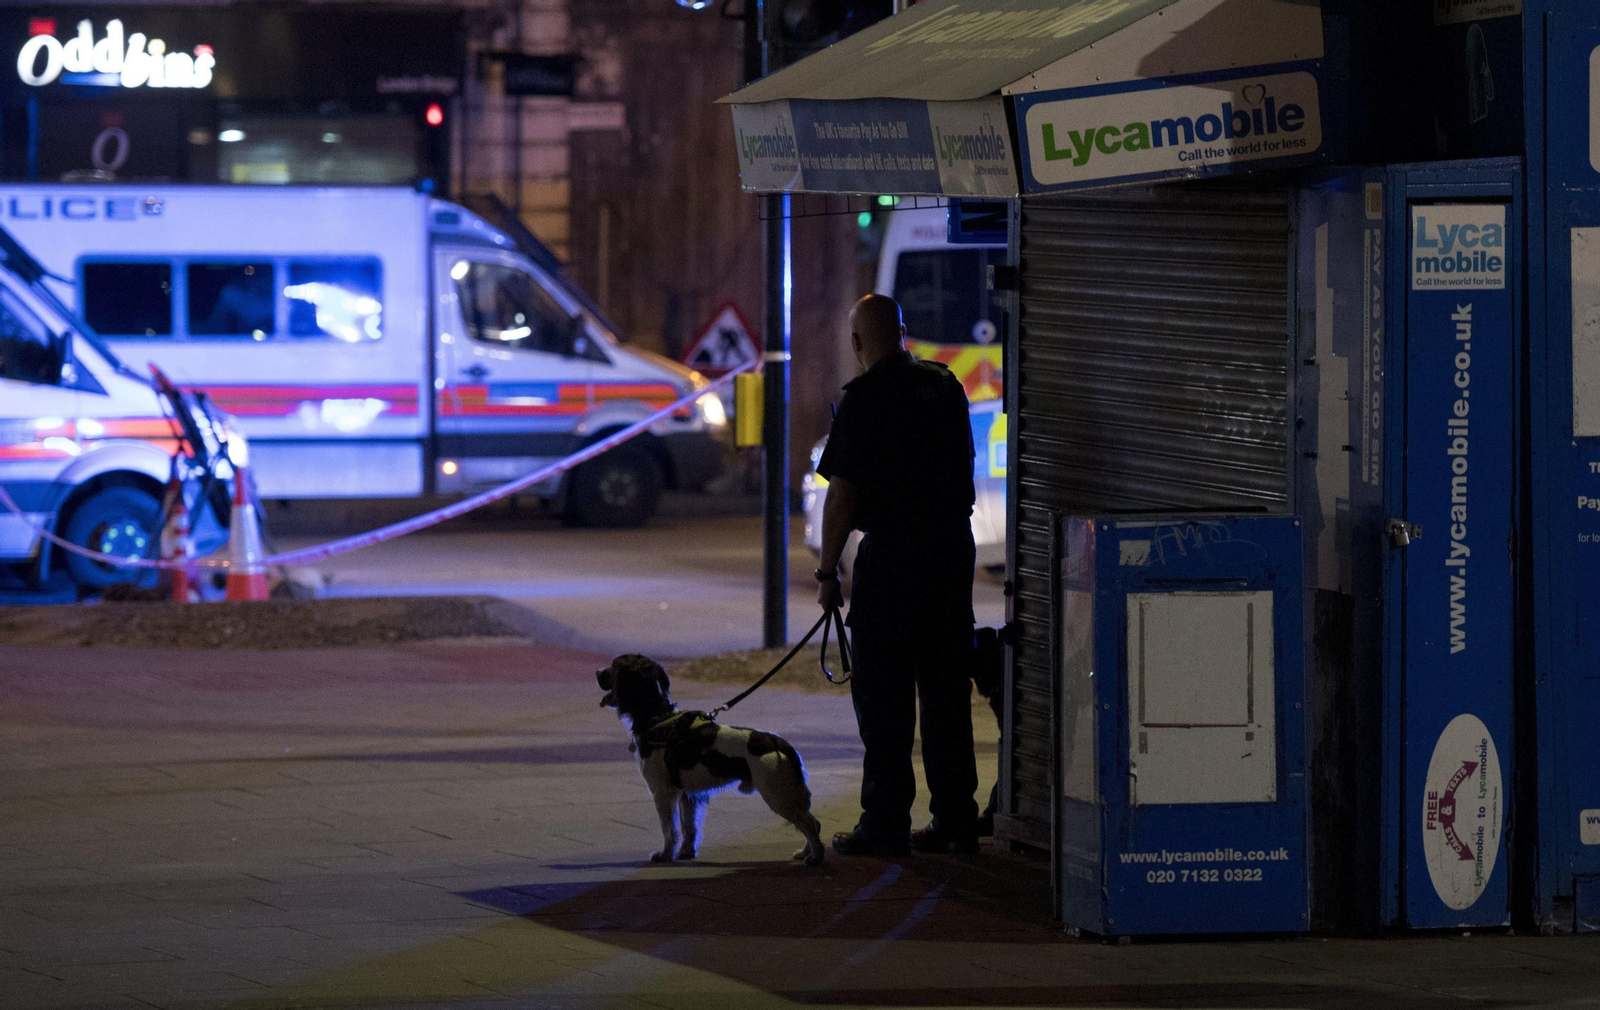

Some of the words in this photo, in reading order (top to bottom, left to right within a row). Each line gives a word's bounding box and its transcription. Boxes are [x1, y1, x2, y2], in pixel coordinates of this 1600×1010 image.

[17, 18, 215, 88] Oddbins
[739, 127, 795, 165] Lycamobile
[936, 125, 1006, 167] Lycamobile
[1041, 97, 1305, 167] Lycamobile
[1178, 148, 1202, 162] Call
[1204, 147, 1225, 159] the
[1226, 142, 1261, 156] world
[1263, 140, 1281, 151] for
[1282, 137, 1307, 149] less
[1373, 228, 1382, 277] PAY
[1416, 216, 1503, 255] Lyca
[1416, 251, 1503, 273] mobile
[1416, 278, 1432, 286] Call
[1433, 278, 1447, 286] the
[1448, 278, 1471, 286] world
[1472, 278, 1484, 286] for
[1373, 284, 1381, 319] AS
[1373, 327, 1381, 382] YOU
[1372, 391, 1380, 430] GO
[1371, 438, 1379, 486] SIM
[1445, 302, 1472, 655] www.lycamobile.co.uk
[1578, 533, 1590, 542] for
[1447, 767, 1467, 792] TEXTS
[1477, 738, 1488, 799] Lycamobile
[1427, 791, 1438, 830] FREE
[1441, 805, 1452, 816] &
[1477, 806, 1486, 818] to
[1119, 847, 1289, 865] www.lycamobile.co.uk
[1445, 826, 1463, 853] CALLS
[1473, 825, 1485, 887] Lycamobile
[1146, 870, 1176, 883] 020
[1180, 869, 1219, 883] 7132
[1223, 868, 1263, 882] 0322
